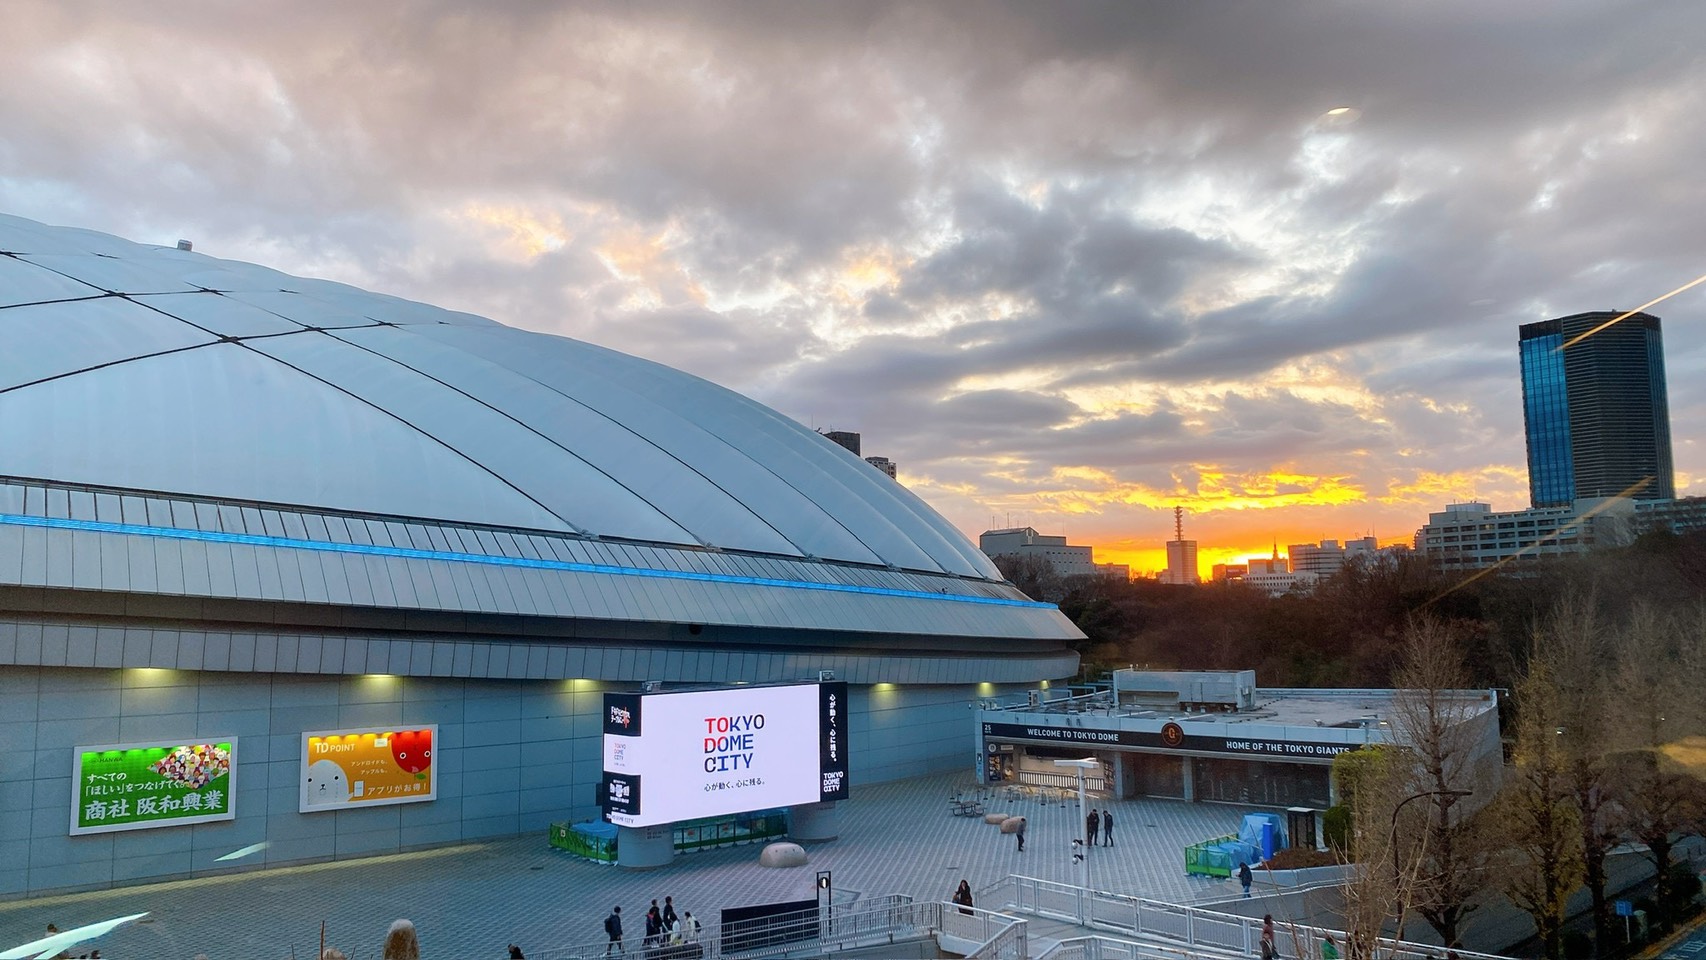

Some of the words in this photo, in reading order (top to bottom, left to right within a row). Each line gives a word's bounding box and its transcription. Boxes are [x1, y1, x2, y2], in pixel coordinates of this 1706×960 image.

[704, 714, 765, 734] TOKYO
[1027, 728, 1061, 738] WELCOME
[1062, 730, 1072, 738] TO
[1072, 731, 1097, 740] TOKYO
[1098, 732, 1119, 741] DOME
[315, 742, 329, 754] TD
[330, 743, 355, 753] POINT
[704, 733, 754, 754] DOME
[1226, 741, 1250, 750] HOME
[1252, 742, 1263, 750] OF
[1265, 743, 1282, 752] THE
[1284, 744, 1314, 753] TOKYO
[704, 752, 753, 773] CITY
[87, 772, 127, 784] すべての
[823, 771, 844, 779] TOKYO
[85, 780, 185, 797] 「ほしい」をつなげてく。
[704, 777, 765, 792] 心が動く、心に残る。
[823, 778, 840, 786] DOME
[367, 782, 427, 796] アプリがお得！
[823, 785, 840, 793] CITY
[84, 798, 131, 820] 商社
[136, 789, 224, 815] 阪和興業
